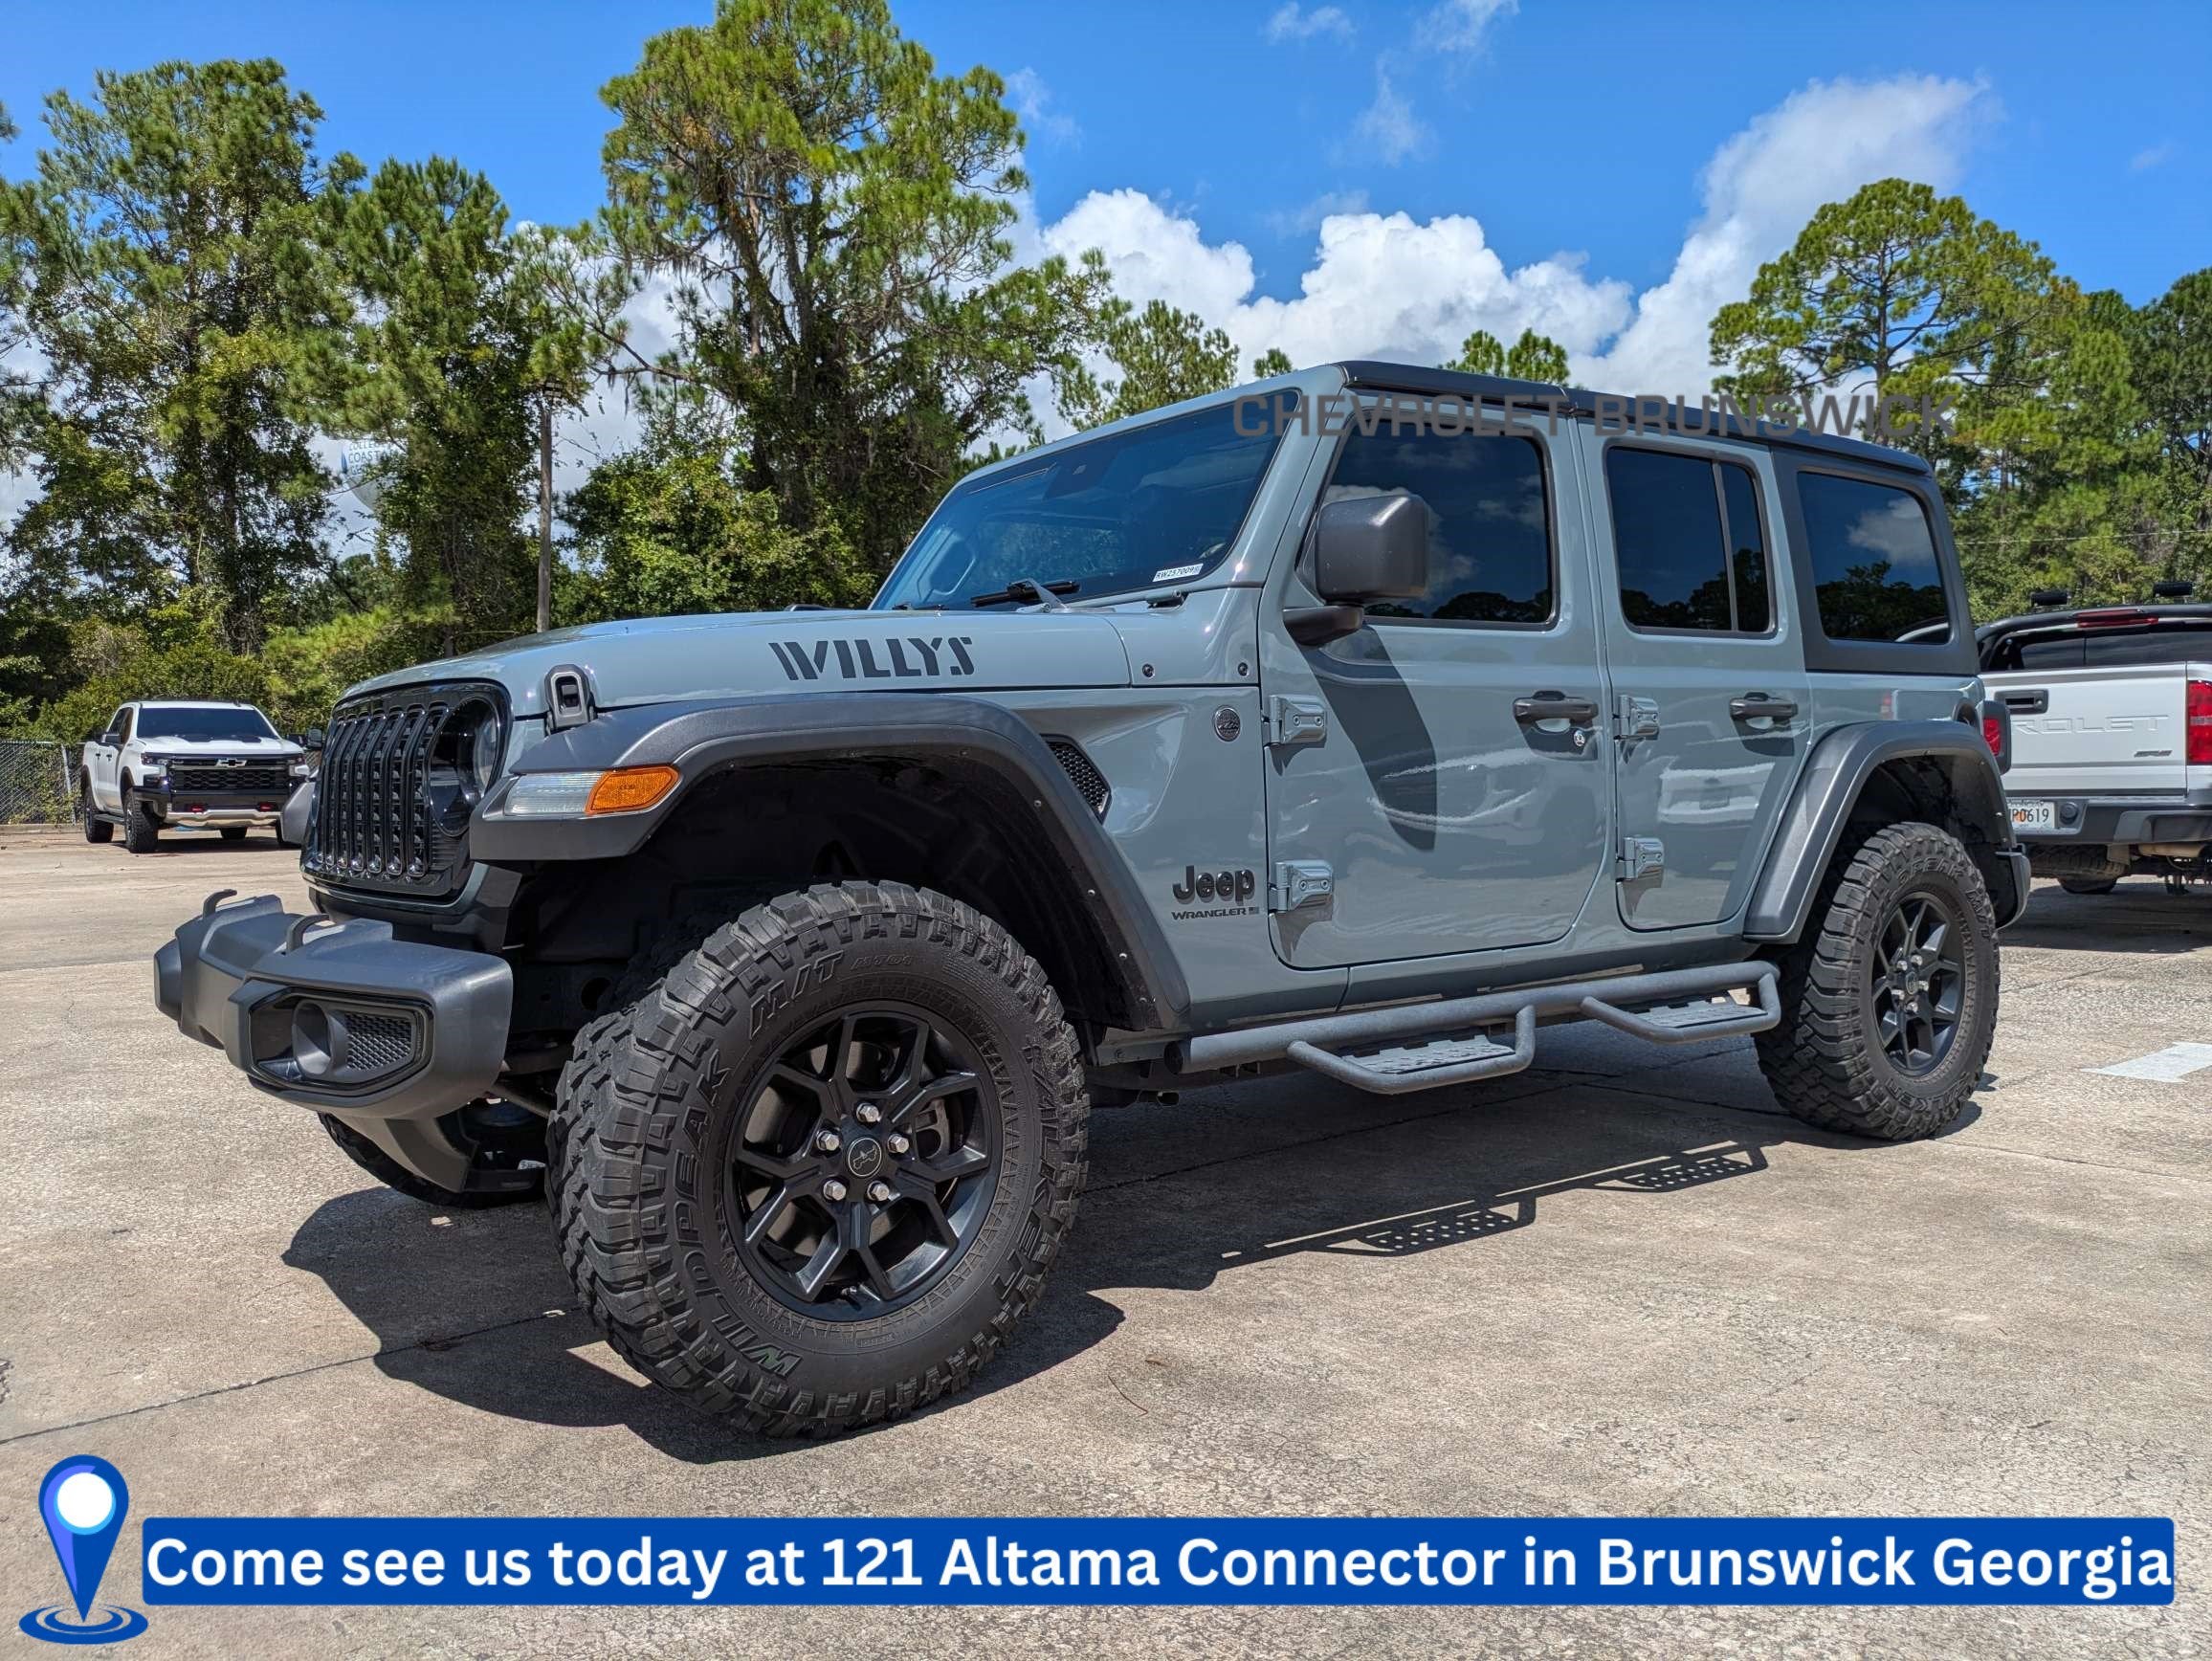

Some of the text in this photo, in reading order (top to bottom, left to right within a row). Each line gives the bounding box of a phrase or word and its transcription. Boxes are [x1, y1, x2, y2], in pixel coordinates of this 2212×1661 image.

[768, 637, 975, 680] WILLYS
[1172, 865, 1255, 903] Jeep
[1171, 907, 1247, 920] WRANGLER
[674, 1048, 803, 1379] WILDPEAK
